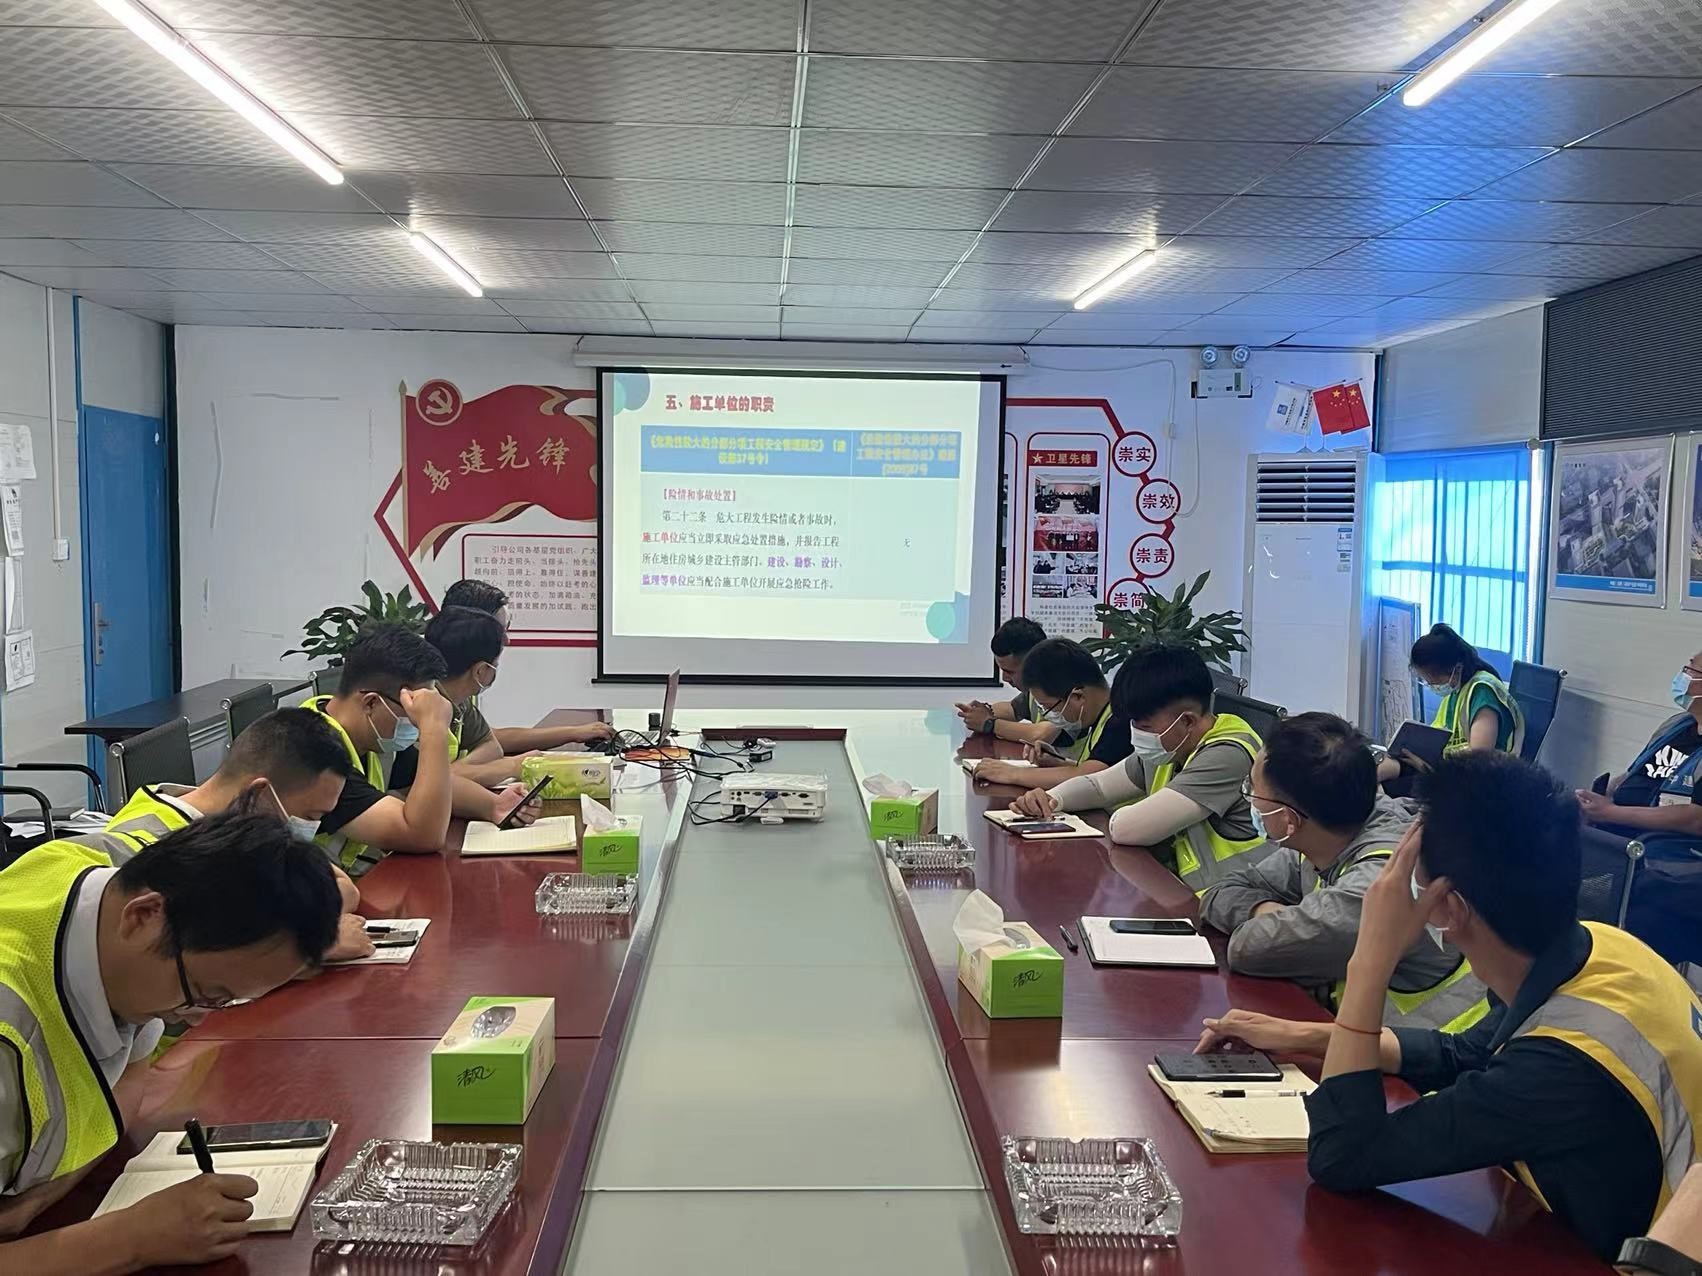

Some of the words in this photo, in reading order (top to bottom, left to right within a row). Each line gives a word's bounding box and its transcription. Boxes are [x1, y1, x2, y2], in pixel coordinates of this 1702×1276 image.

[665, 394, 775, 413] 五、施工单位的职责
[1045, 452, 1092, 465] 卫星先锋
[1118, 446, 1151, 463] 崇实
[1142, 493, 1176, 510] 崇效
[662, 510, 708, 523] 第二十二条
[1136, 547, 1169, 564] 崇责
[1114, 592, 1145, 608] 崇简
[1013, 969, 1044, 988] 清风
[456, 1065, 497, 1088] 清风
